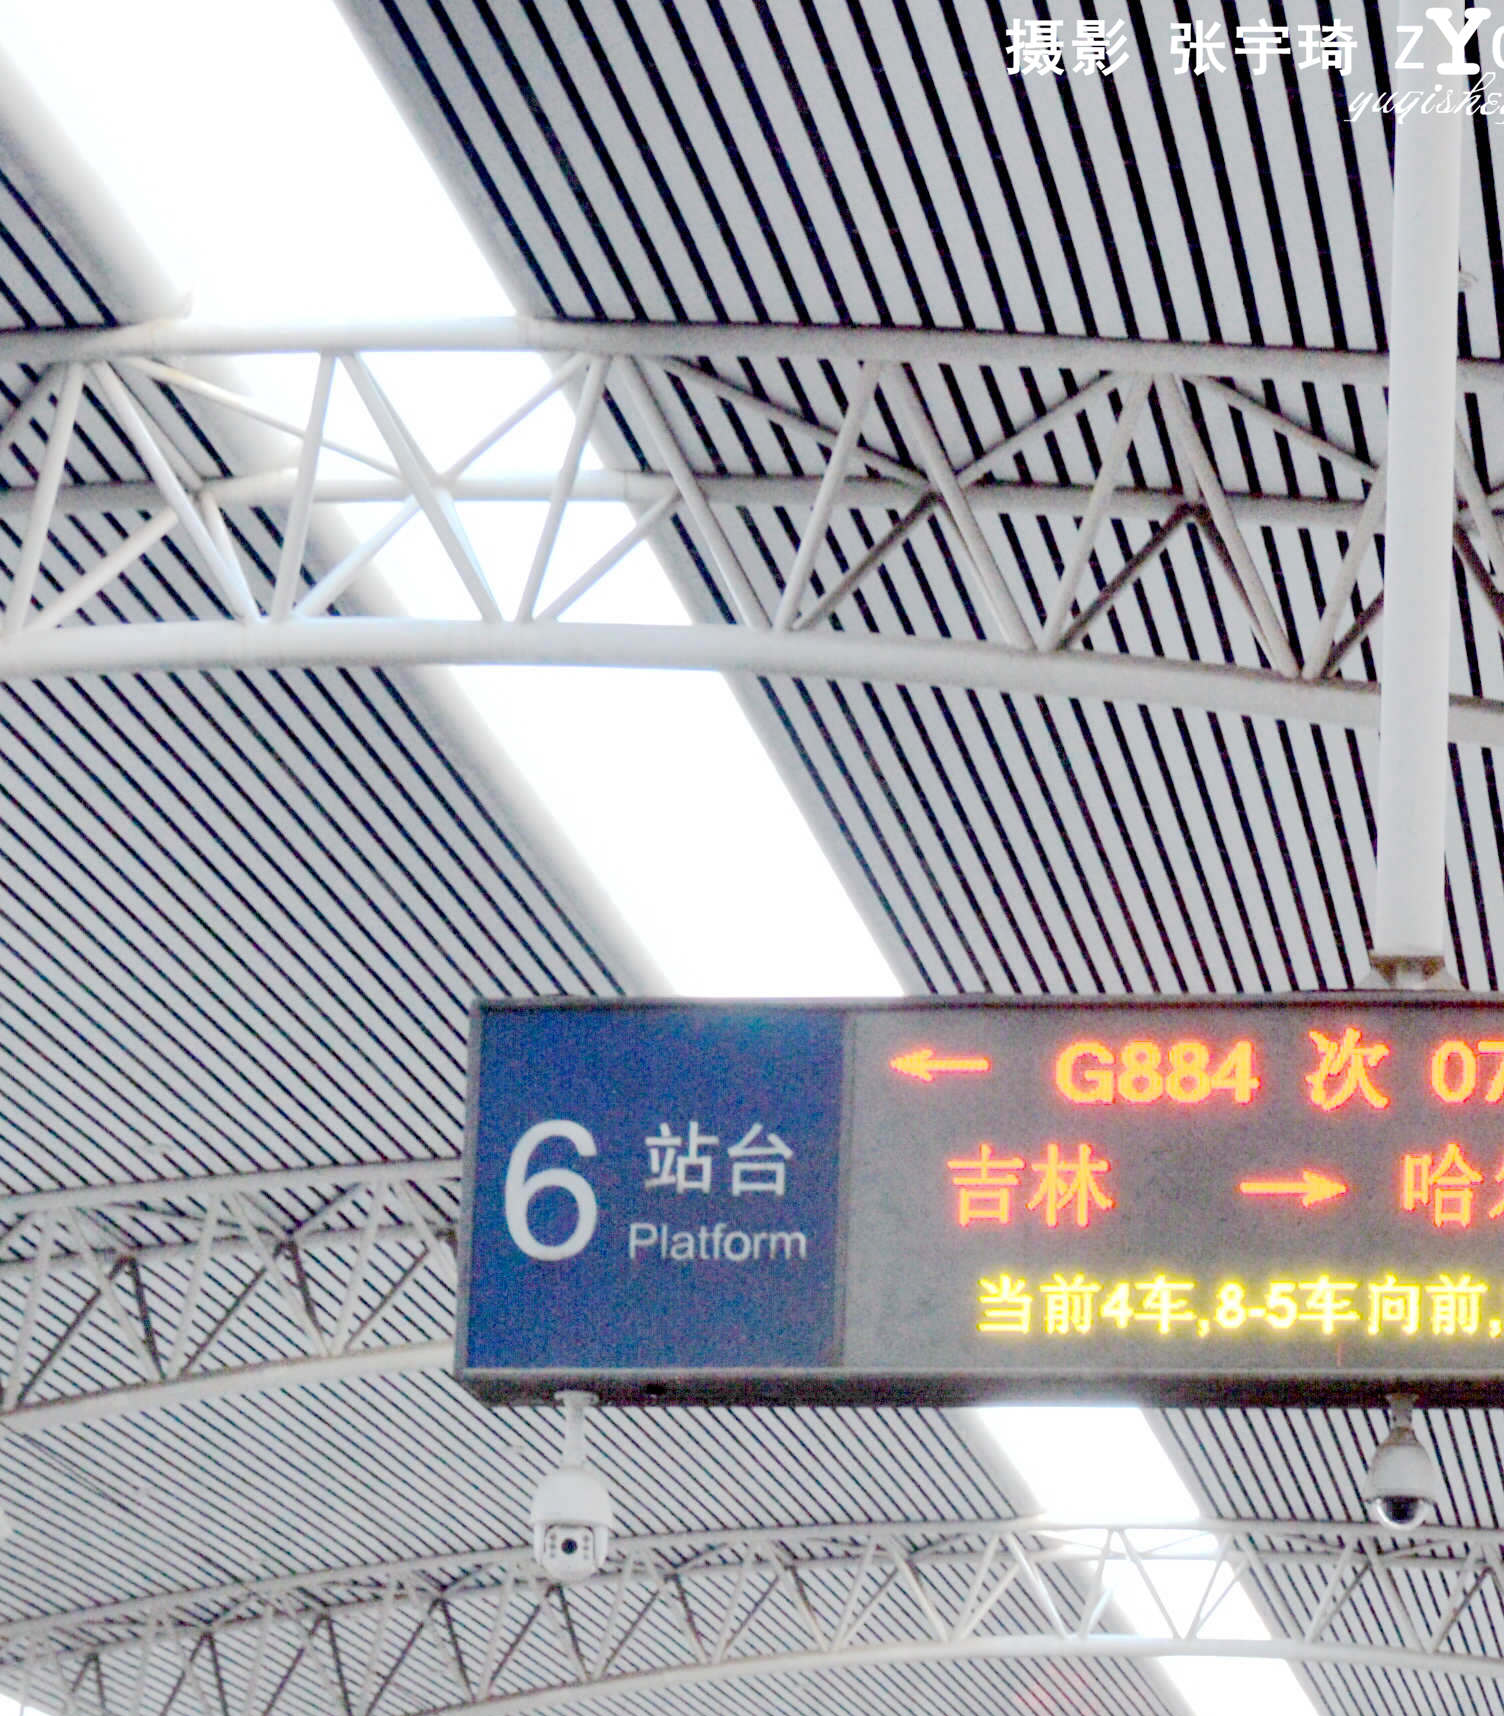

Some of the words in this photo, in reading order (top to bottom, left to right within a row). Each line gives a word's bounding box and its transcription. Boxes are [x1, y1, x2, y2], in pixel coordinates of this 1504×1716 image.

[1053, 1038, 1263, 1106] G884
[1305, 1025, 1392, 1112] 次
[504, 1119, 598, 1261] 6
[644, 1120, 794, 1196] 站台
[946, 1142, 1116, 1230] 吉林
[628, 1221, 808, 1263] Platform
